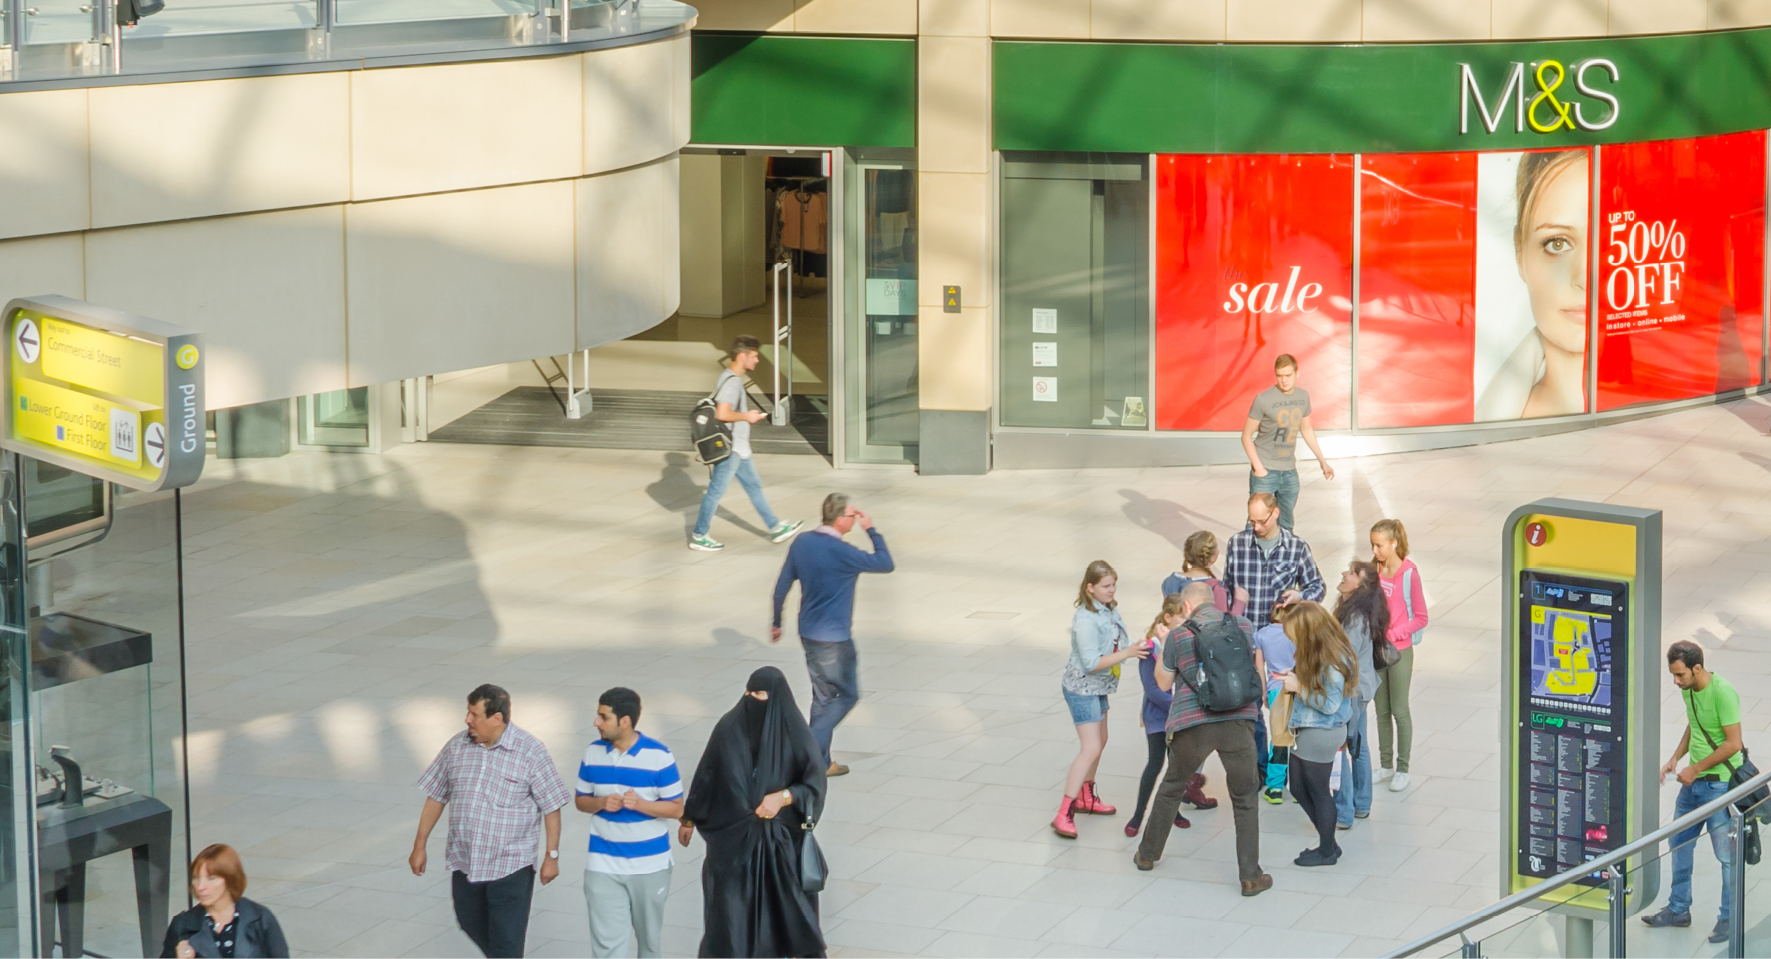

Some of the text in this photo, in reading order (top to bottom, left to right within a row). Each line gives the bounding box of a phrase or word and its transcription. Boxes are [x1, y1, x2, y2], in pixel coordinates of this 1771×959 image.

[1458, 58, 1620, 135] M&S
[1608, 210, 1635, 224] UP TO
[1608, 219, 1686, 266] 50%
[884, 289, 907, 298] DAYS
[1223, 265, 1323, 314] sale
[1607, 261, 1685, 311] OFF
[1607, 309, 1648, 321] SELECTED ITEMS
[1637, 318, 1658, 326] online
[1663, 313, 1686, 323] mobile
[48, 336, 122, 368] Commercial Street
[181, 348, 195, 365] G
[29, 398, 106, 432] Lower Ground Floor
[178, 383, 197, 453] Ground
[1277, 408, 1303, 427] CO
[66, 428, 107, 452] First Floor
[1273, 426, 1299, 444] RE
[1534, 609, 1541, 619] G
[1532, 712, 1543, 724] LG
